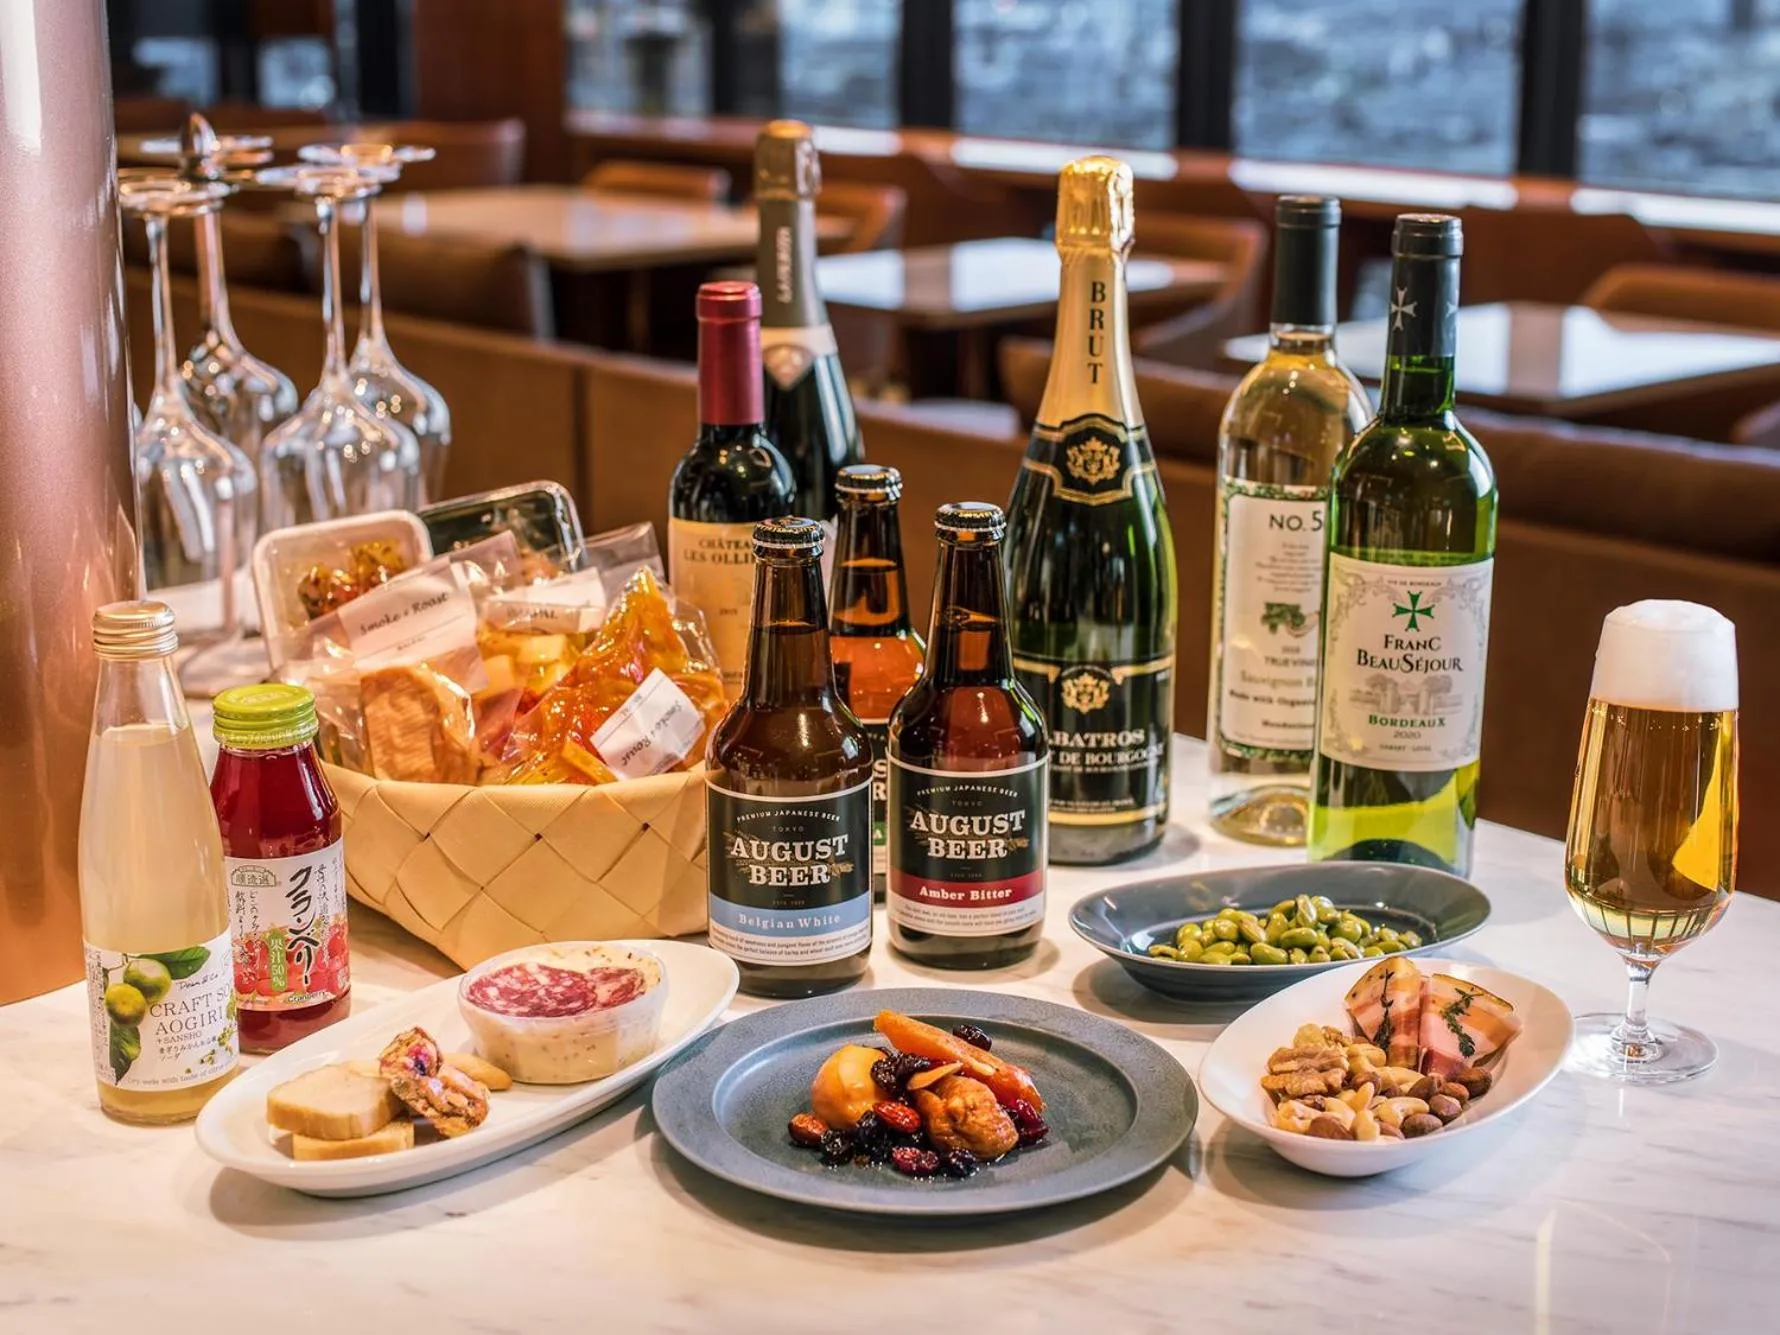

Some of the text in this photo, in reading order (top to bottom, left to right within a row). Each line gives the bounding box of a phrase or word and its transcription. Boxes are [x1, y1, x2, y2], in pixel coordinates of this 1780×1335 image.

[1087, 281, 1106, 384] BRUT
[684, 549, 706, 562] LES
[1368, 714, 1446, 729] BORDEAUX
[1049, 728, 1145, 748] BATROS
[1393, 730, 1421, 740] 2020
[1060, 752, 1080, 765] DE
[917, 784, 1019, 798] PREMIUM JAPANESE BEER
[736, 809, 841, 823] PREMIUM JAPANESE BEER
[909, 809, 1026, 836] AUGUST
[730, 834, 849, 862] AUGUST
[927, 838, 1008, 860] BEER
[749, 863, 831, 887] BEER
[919, 886, 1013, 901] Amber Bitter
[285, 865, 319, 985] クランベリー
[738, 913, 841, 930] Belgian White
[150, 992, 213, 1018] CRAFT
[155, 1006, 223, 1036] AOGIRI
